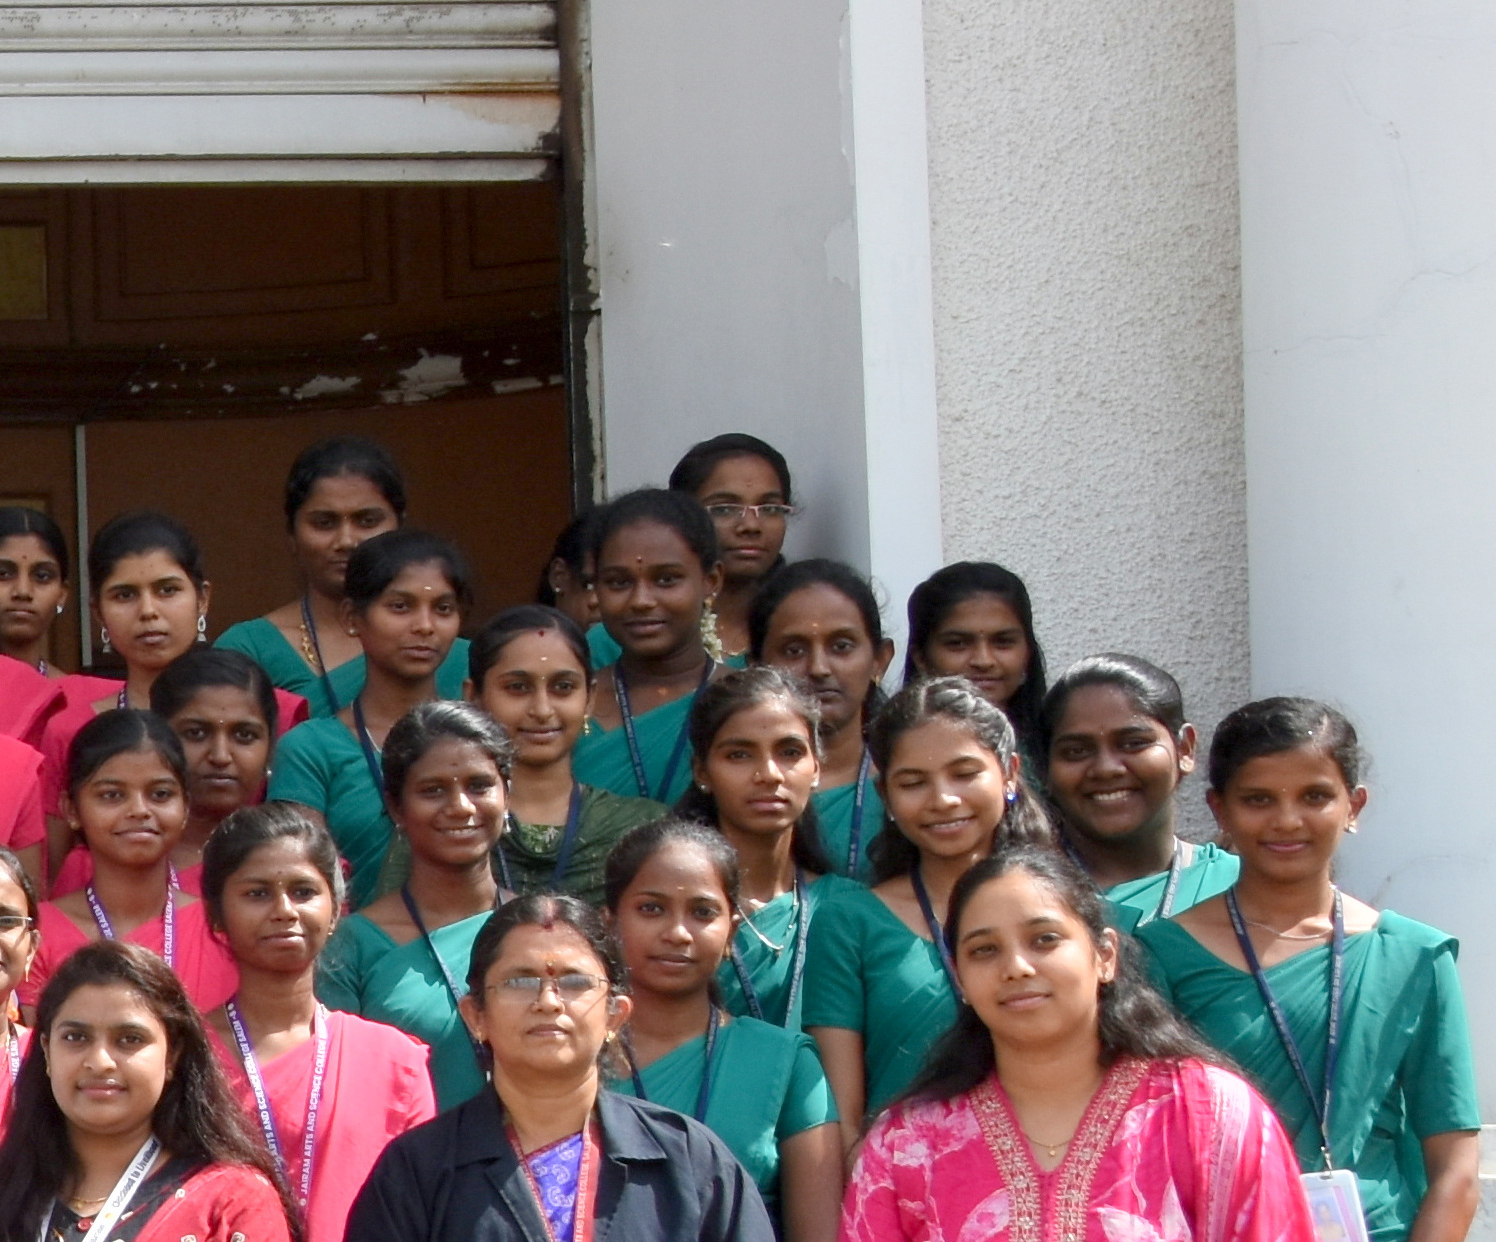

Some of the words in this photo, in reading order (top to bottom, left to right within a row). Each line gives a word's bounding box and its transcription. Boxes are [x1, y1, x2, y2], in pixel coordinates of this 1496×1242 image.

[164, 924, 172, 954] COLLEGE
[260, 1109, 272, 1131] AND
[306, 1111, 316, 1131] AND
[304, 1133, 313, 1156] ARTS
[300, 1158, 311, 1194] JAIRAM
